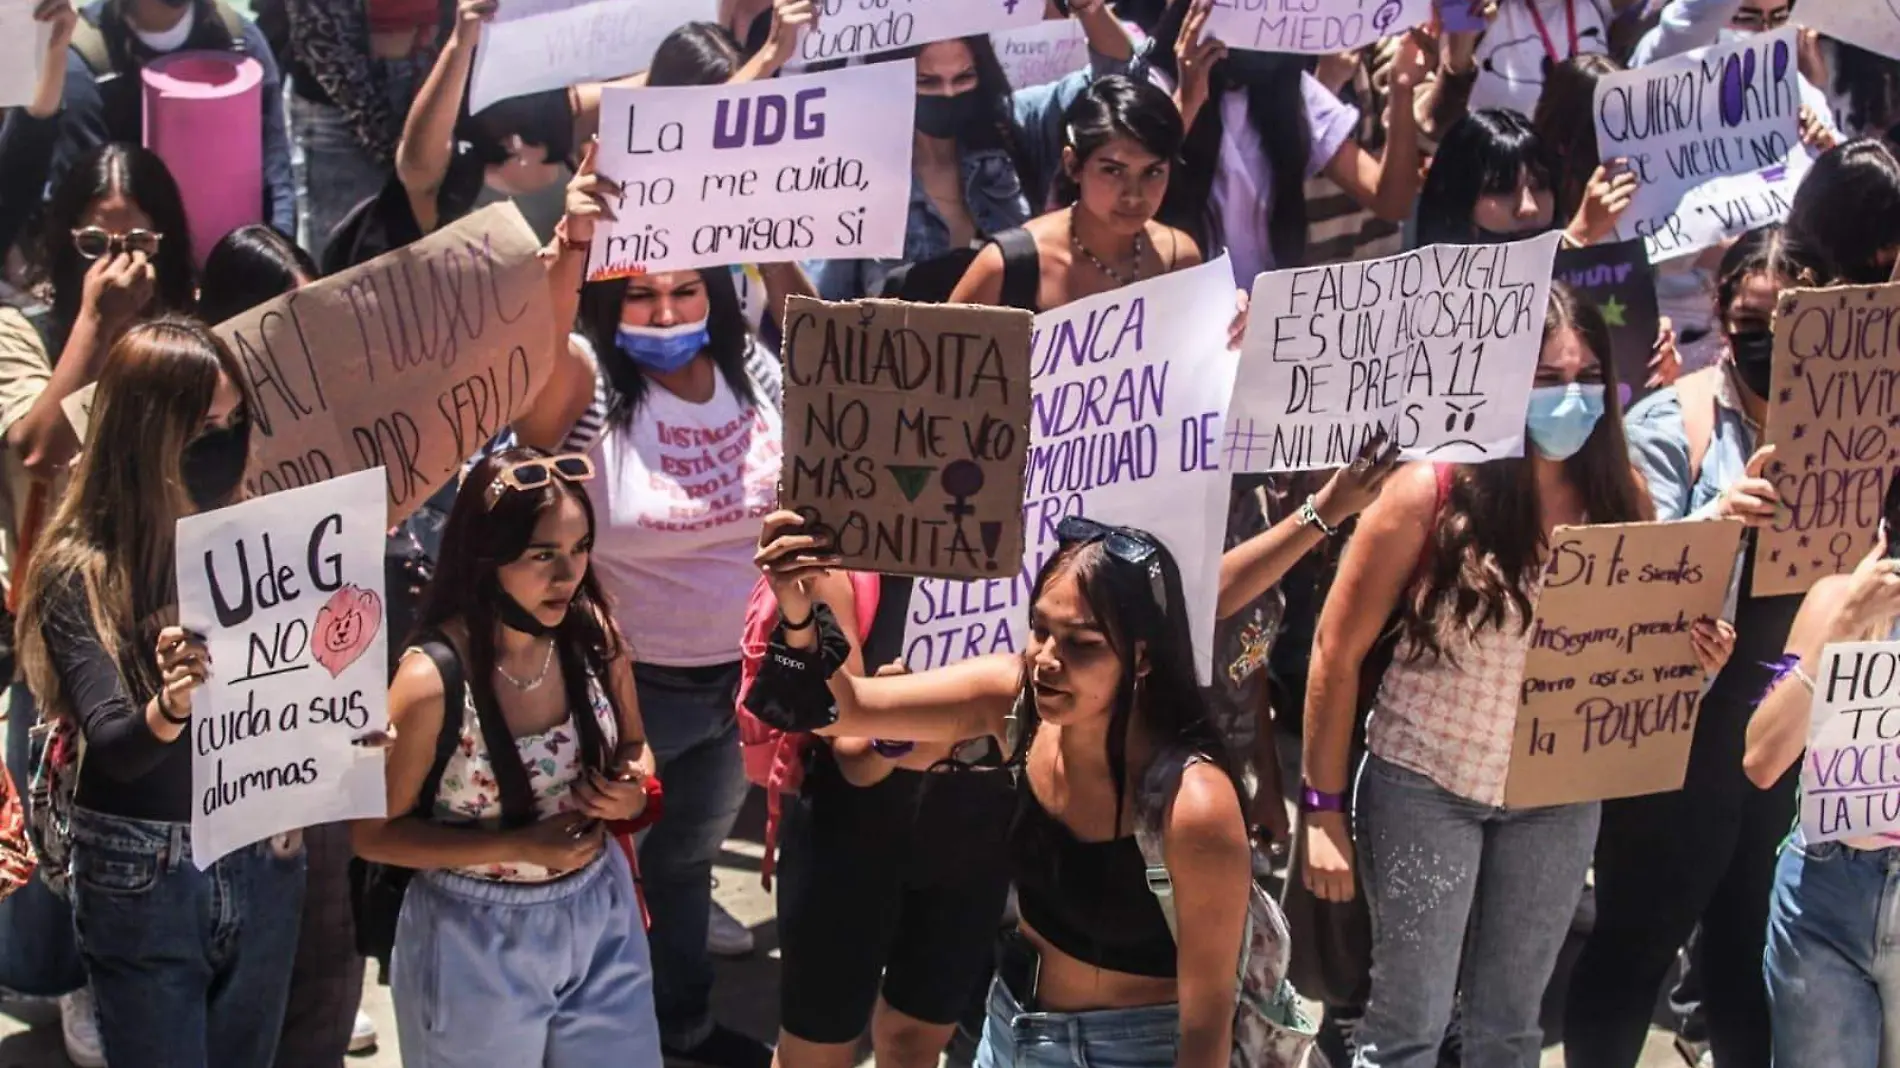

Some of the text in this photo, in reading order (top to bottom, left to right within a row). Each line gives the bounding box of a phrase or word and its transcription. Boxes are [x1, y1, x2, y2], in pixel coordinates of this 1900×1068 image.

[1254, 14, 1363, 49] MIEDO
[627, 87, 827, 154] La UDG
[1750, 130, 1788, 167] NO
[619, 156, 870, 210] no me cuida,
[606, 224, 670, 266] mis
[691, 214, 814, 255] amigas
[1289, 254, 1423, 314] FAUSTO
[1434, 245, 1525, 290] VIGIL
[789, 313, 1009, 405] CALLADITA
[1273, 312, 1327, 362] ES
[1339, 309, 1385, 359] UN
[1285, 364, 1333, 414] DE
[1440, 341, 1484, 396] 11
[805, 392, 869, 452] NO
[894, 407, 952, 459] ME
[963, 412, 1015, 461] VEO
[1026, 412, 1219, 498] MODIDAD DE
[1607, 534, 1630, 587] te
[1638, 544, 1703, 585] sientes
[247, 618, 308, 678] NO
[1826, 651, 1900, 702] HO
[197, 690, 369, 756] cuida a sus
[1529, 718, 1555, 756] la
[203, 756, 318, 815] alumnas
[1820, 796, 1852, 834] LA
